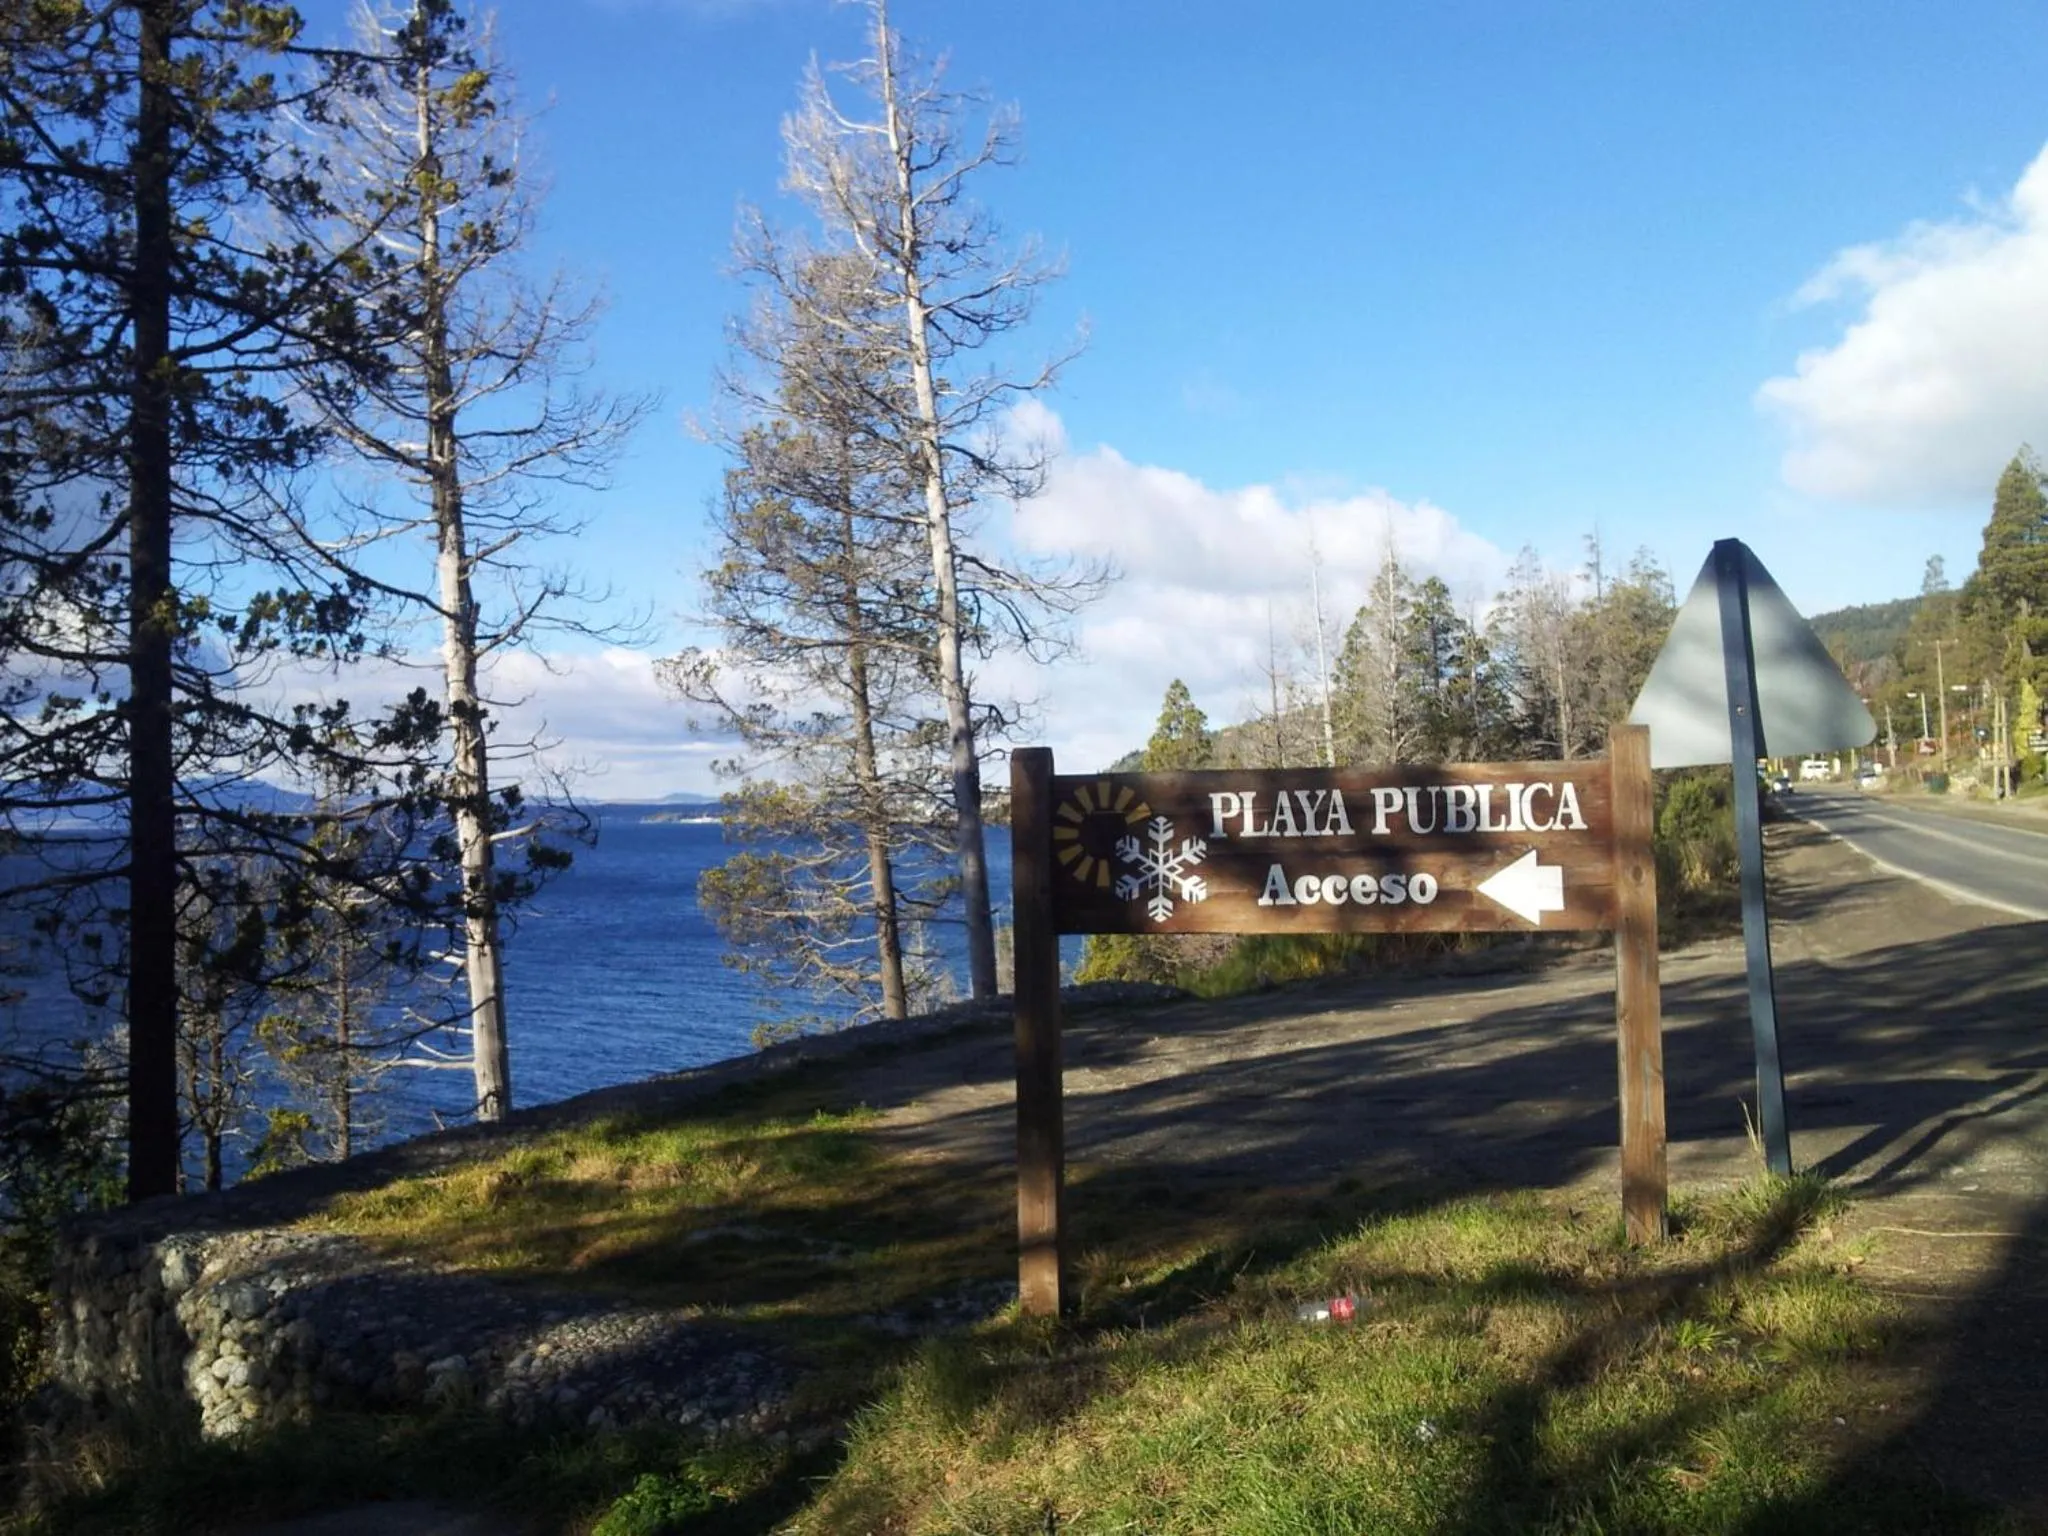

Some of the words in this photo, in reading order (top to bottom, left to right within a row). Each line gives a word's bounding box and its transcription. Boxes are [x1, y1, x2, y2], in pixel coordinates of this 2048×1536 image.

[1208, 787, 1355, 838] PLAYA
[1370, 781, 1588, 834] PUBLICA
[1257, 863, 1439, 906] Acceso
